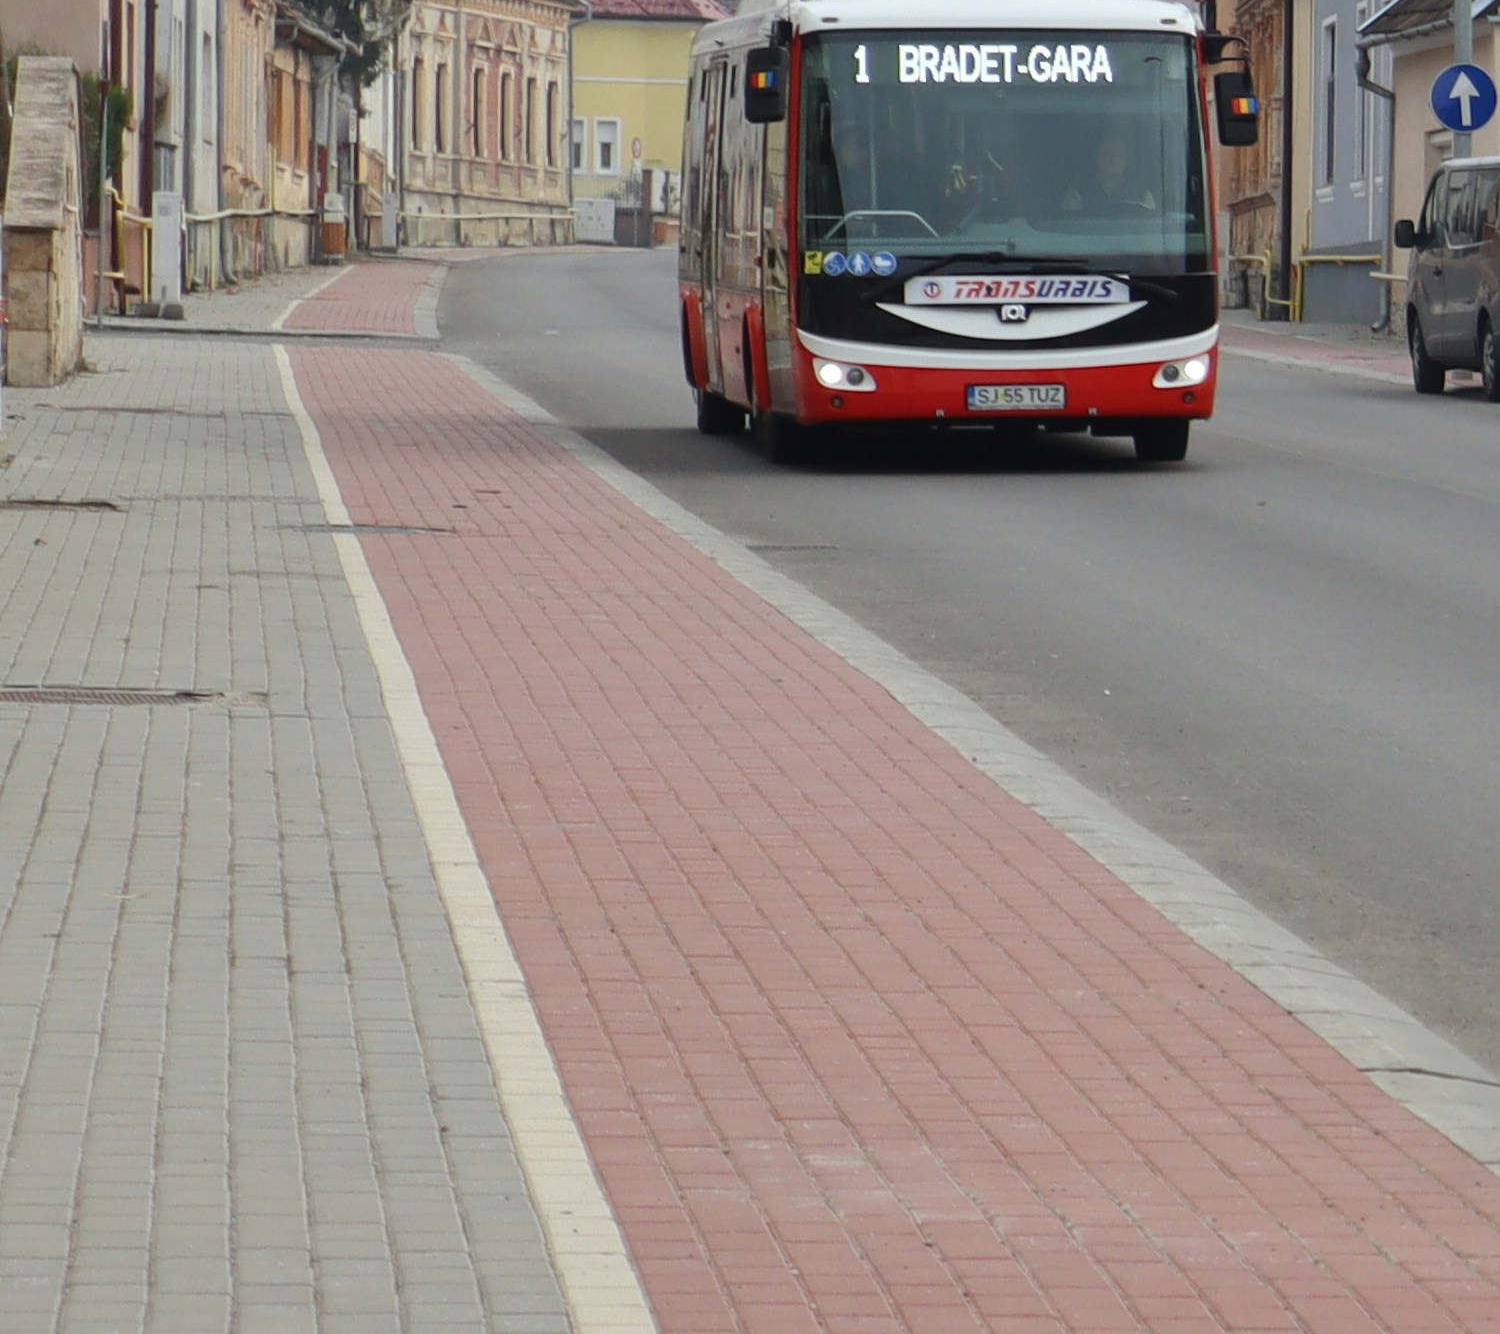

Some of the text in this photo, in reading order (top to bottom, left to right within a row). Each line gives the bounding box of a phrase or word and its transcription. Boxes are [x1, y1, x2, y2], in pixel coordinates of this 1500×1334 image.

[853, 44, 1114, 83] 1 BRADET-GARA
[954, 279, 1113, 299] TRANSURBIS
[977, 387, 1061, 405] SJ 55 TUZ
